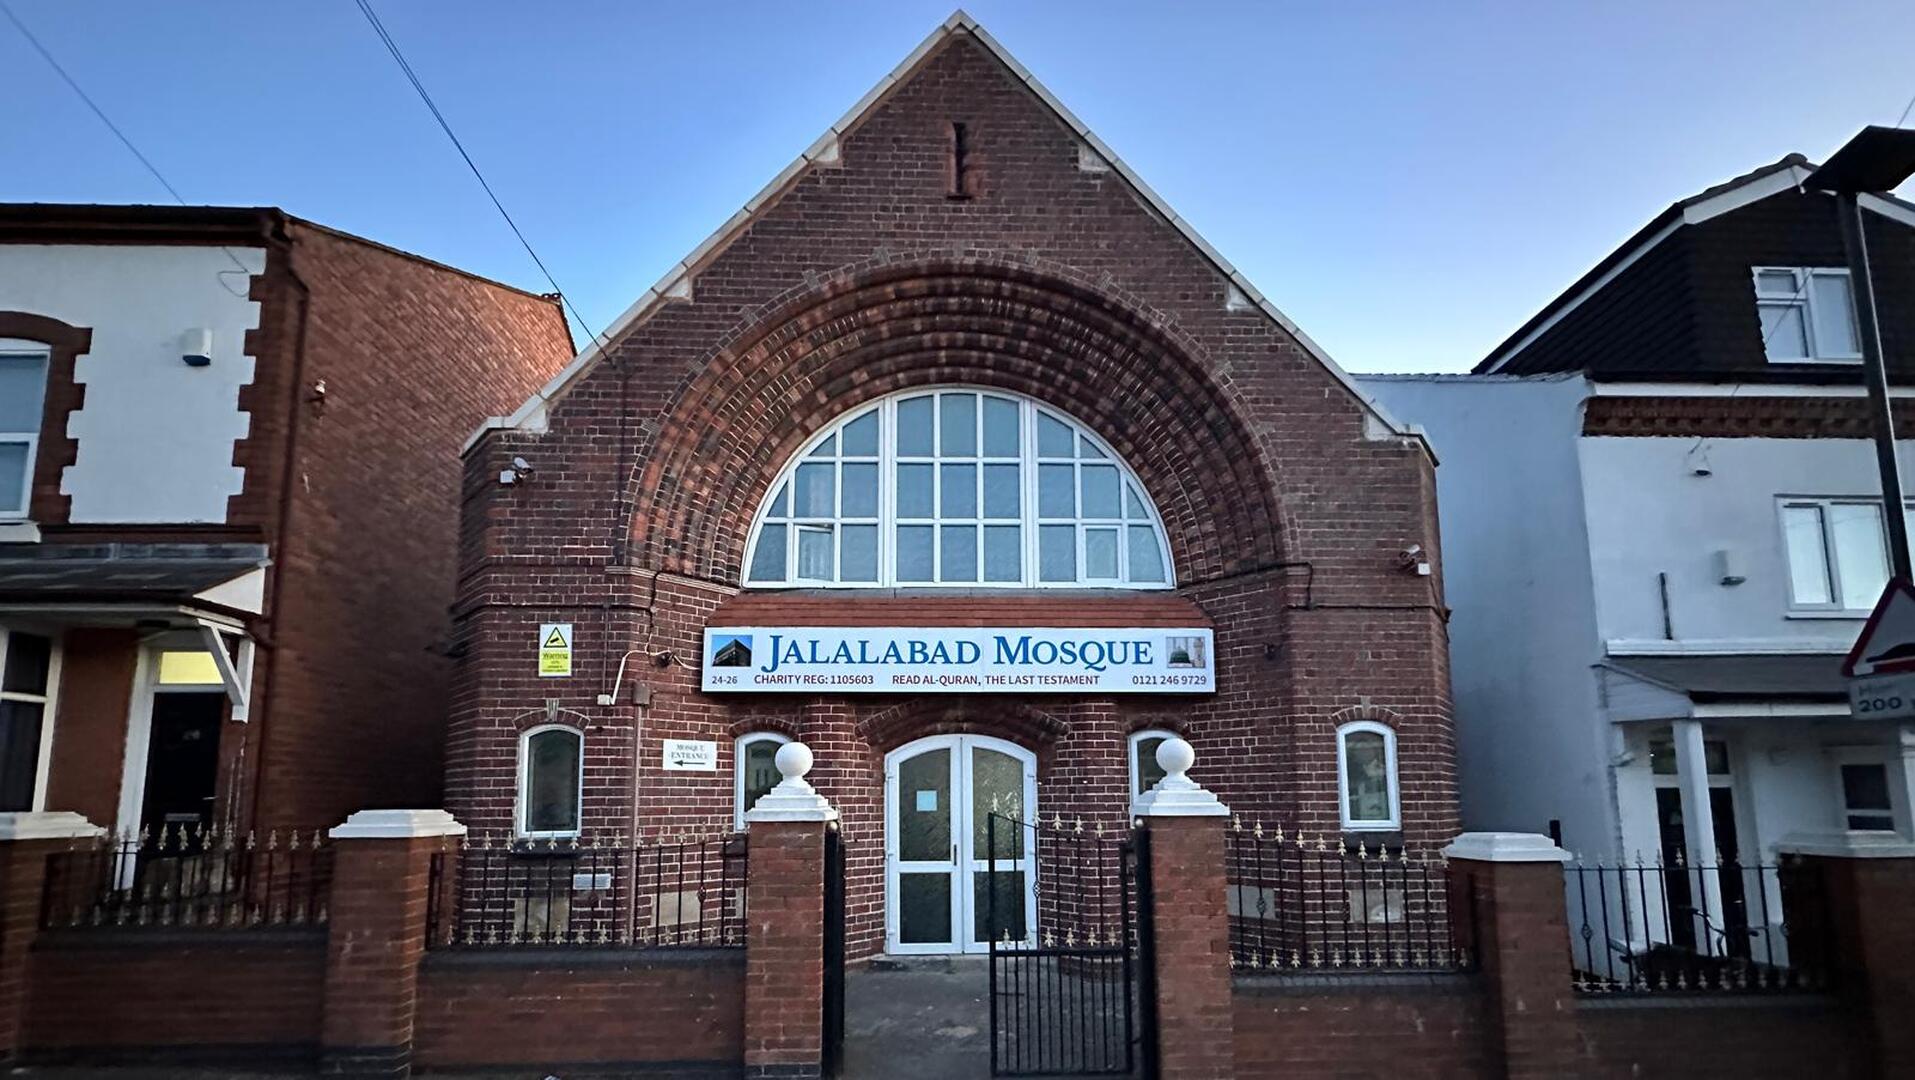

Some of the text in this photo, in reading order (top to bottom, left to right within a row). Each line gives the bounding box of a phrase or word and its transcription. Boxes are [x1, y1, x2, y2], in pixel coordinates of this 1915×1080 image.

[760, 634, 1154, 673] JALALABAD MOSQUE
[711, 674, 1207, 687] 24-26 CHARITY REG: 1105603 READ AL-QURAN, THE LAST TESTAMENT 0121 246 9729
[1858, 697, 1902, 712] 200
